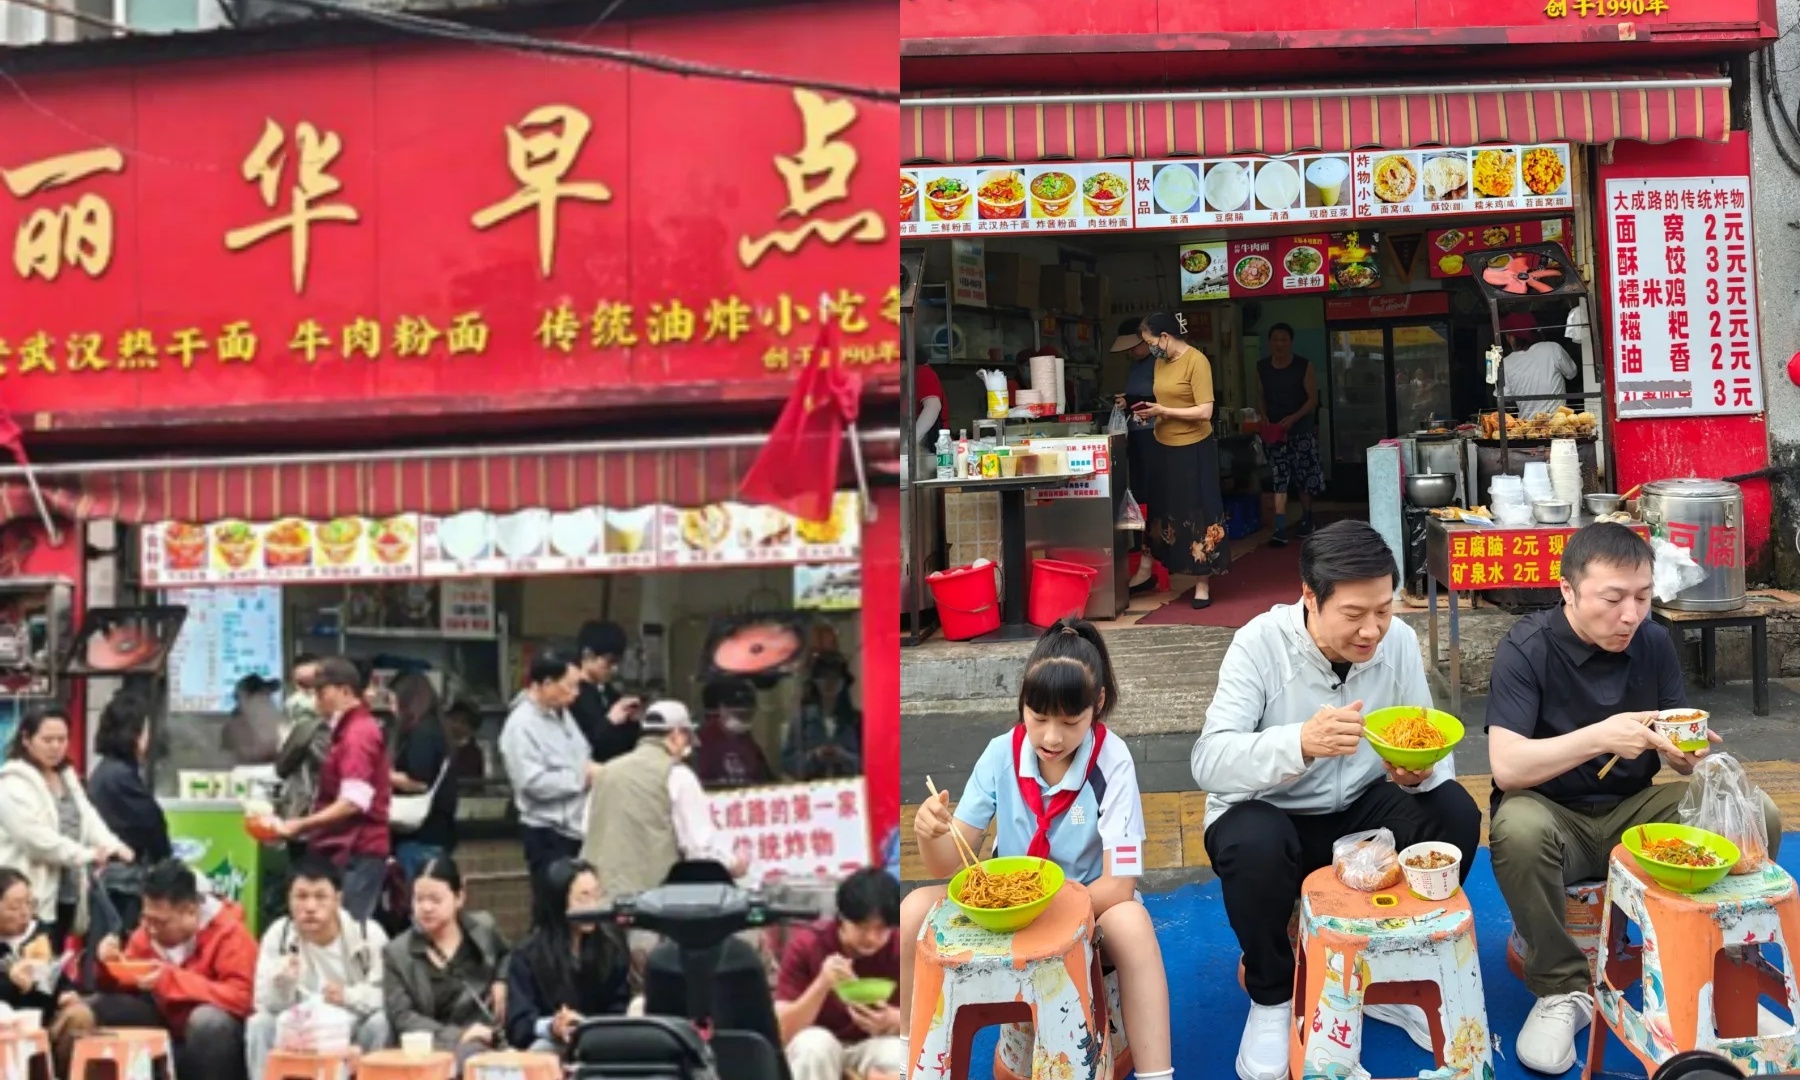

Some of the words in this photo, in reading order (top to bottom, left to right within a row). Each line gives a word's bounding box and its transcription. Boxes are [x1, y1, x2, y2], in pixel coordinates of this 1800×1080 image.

[0, 88, 888, 294] 丽华早点
[1136, 177, 1151, 215] 饮品
[1356, 154, 1371, 216] 炸物小吃
[1613, 187, 1745, 211] 大成路的传统炸物
[930, 223, 972, 233] 三鲜粉面
[978, 220, 1030, 231] 武汉热干面
[1036, 218, 1077, 229] 炸酱粉面
[1088, 217, 1128, 228] 肉丝粉面
[1169, 214, 1189, 224] 蛋酒
[1269, 211, 1289, 221] 清酒
[1309, 207, 1348, 218] 现磨豆浆
[1285, 277, 1321, 288] 三鲜粉
[1618, 278, 1687, 310] 糯米鸡
[289, 312, 488, 361] 牛肉粉面
[1452, 536, 1504, 558] 豆腐脑
[1512, 535, 1539, 556] 2元
[1548, 534, 1575, 556] 现
[1452, 562, 1505, 585] 矿泉水
[1513, 561, 1540, 582] 2元
